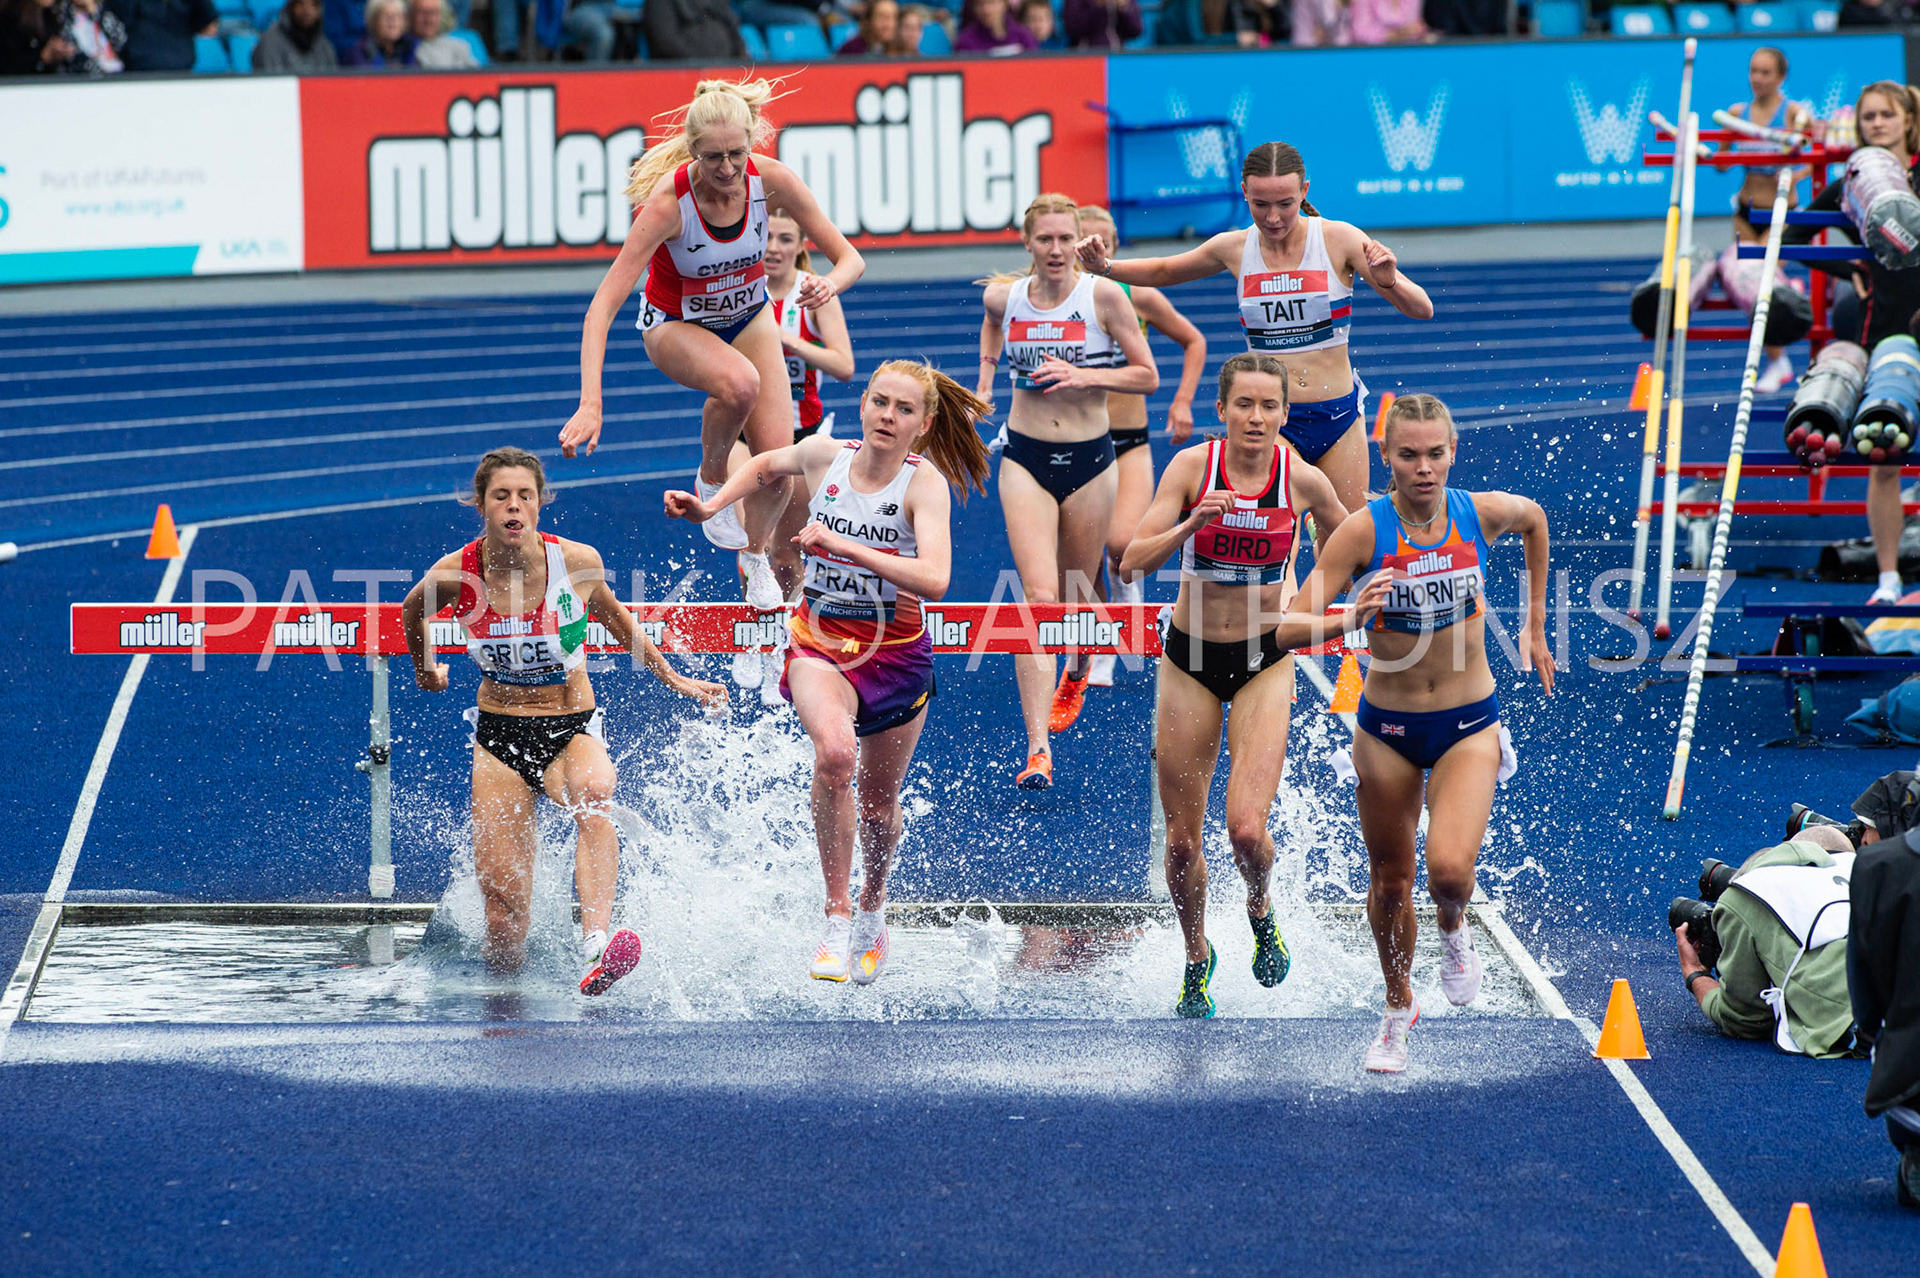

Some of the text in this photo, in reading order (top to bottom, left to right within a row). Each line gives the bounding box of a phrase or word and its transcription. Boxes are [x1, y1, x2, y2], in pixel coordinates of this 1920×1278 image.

[778, 71, 1053, 237] müller
[366, 84, 646, 255] müller
[697, 250, 762, 277] CYMRU
[706, 273, 746, 293] müller
[1260, 273, 1304, 294] müller
[689, 282, 758, 313] SEARY
[1260, 298, 1307, 323] TAIT
[1026, 322, 1065, 340] müller
[1265, 334, 1314, 346] MANCHESTER
[1222, 510, 1270, 530] müller
[1213, 533, 1271, 560] BIRD
[1212, 570, 1262, 582] MANCHESTER
[1406, 551, 1453, 577] müller
[814, 561, 884, 596] PRATT
[1388, 574, 1478, 608] THORNER
[820, 603, 872, 616] MANCHESTER
[1406, 613, 1459, 630] MANCHESTER
[120, 611, 206, 647] müller
[274, 611, 360, 647] müller
[489, 616, 534, 636] müller
[927, 612, 971, 647] ller
[1038, 611, 1123, 647] müller
[480, 640, 551, 666] GRICE
[496, 672, 544, 684] MANCHESTER
